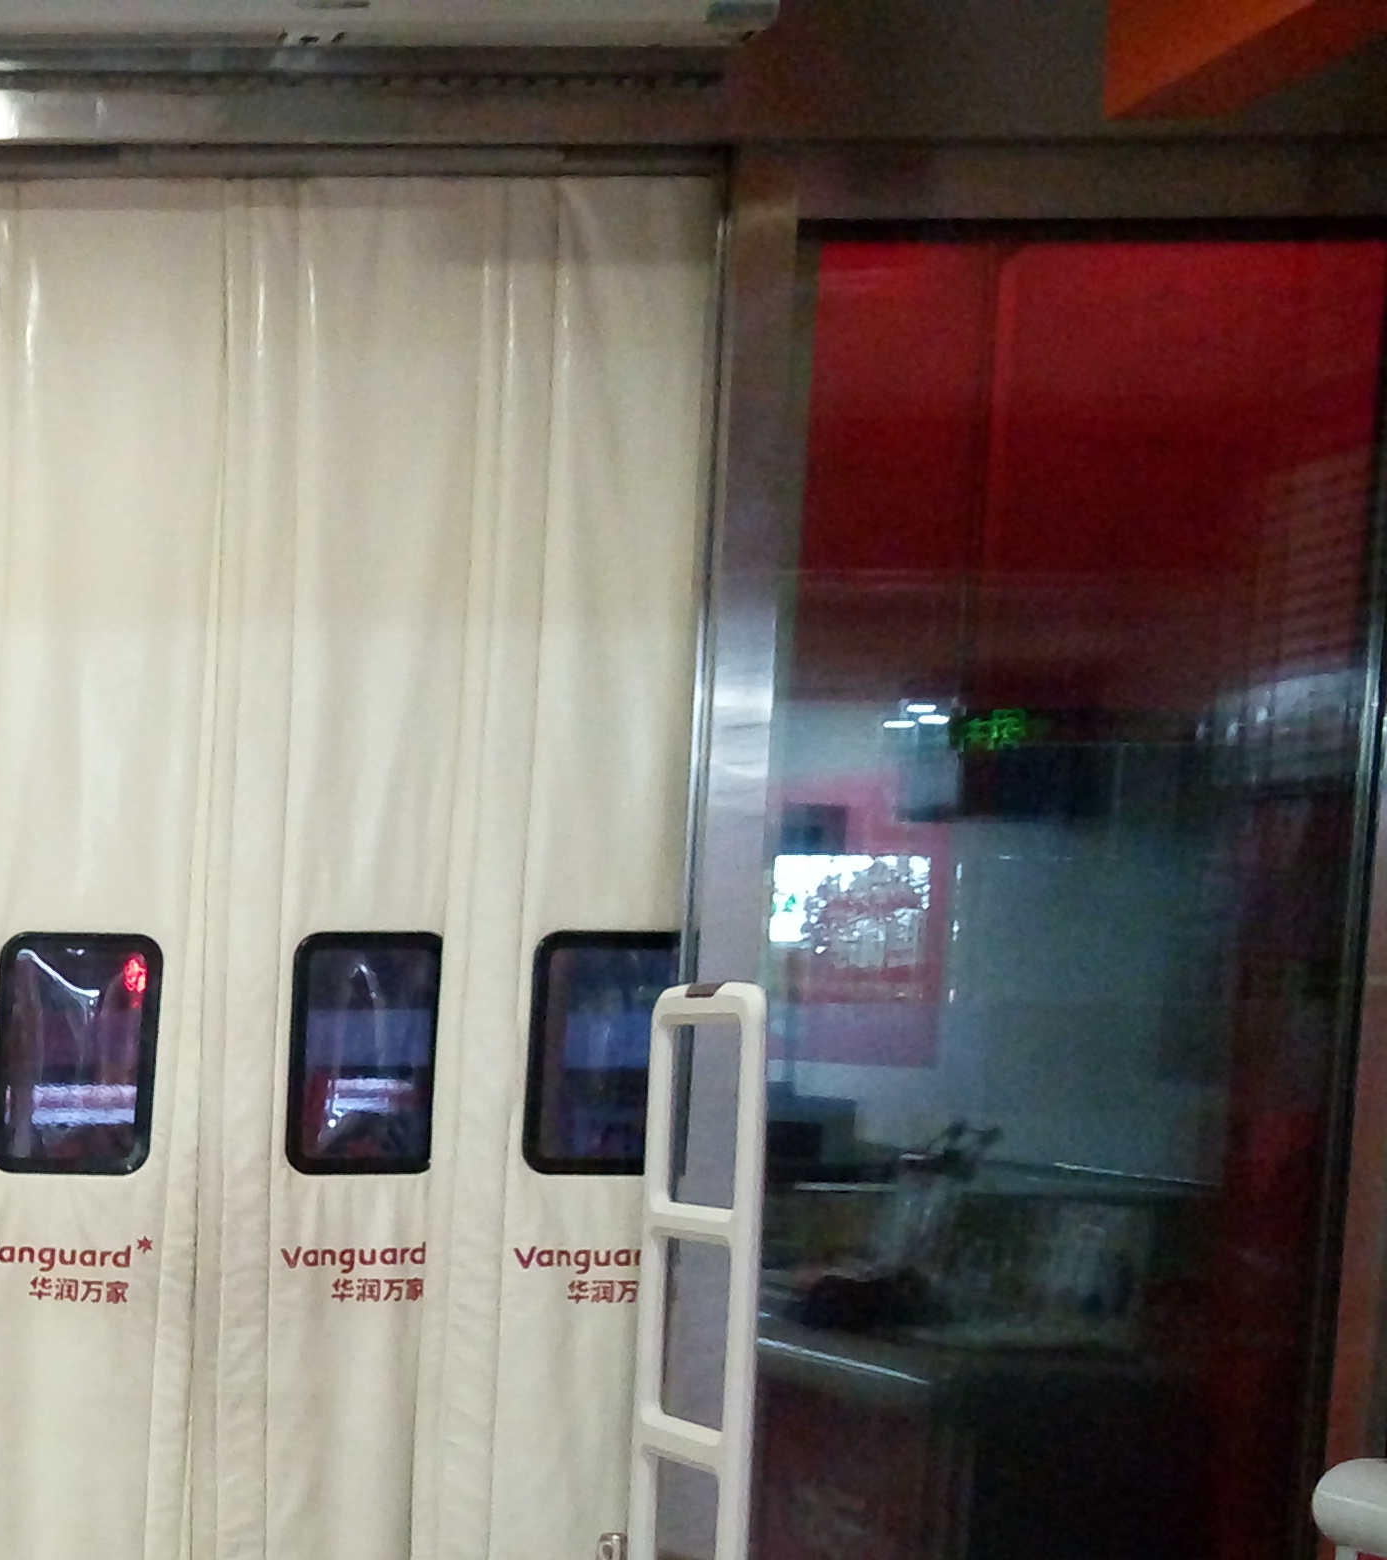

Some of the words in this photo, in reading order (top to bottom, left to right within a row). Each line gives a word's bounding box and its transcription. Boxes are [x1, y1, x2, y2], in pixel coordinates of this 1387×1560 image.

[280, 1241, 426, 1273] Vanguard
[513, 1246, 642, 1274] Vangua
[28, 1276, 129, 1304] 华润万家
[331, 1278, 424, 1302] 华润万家
[567, 1280, 638, 1304] 华润万
